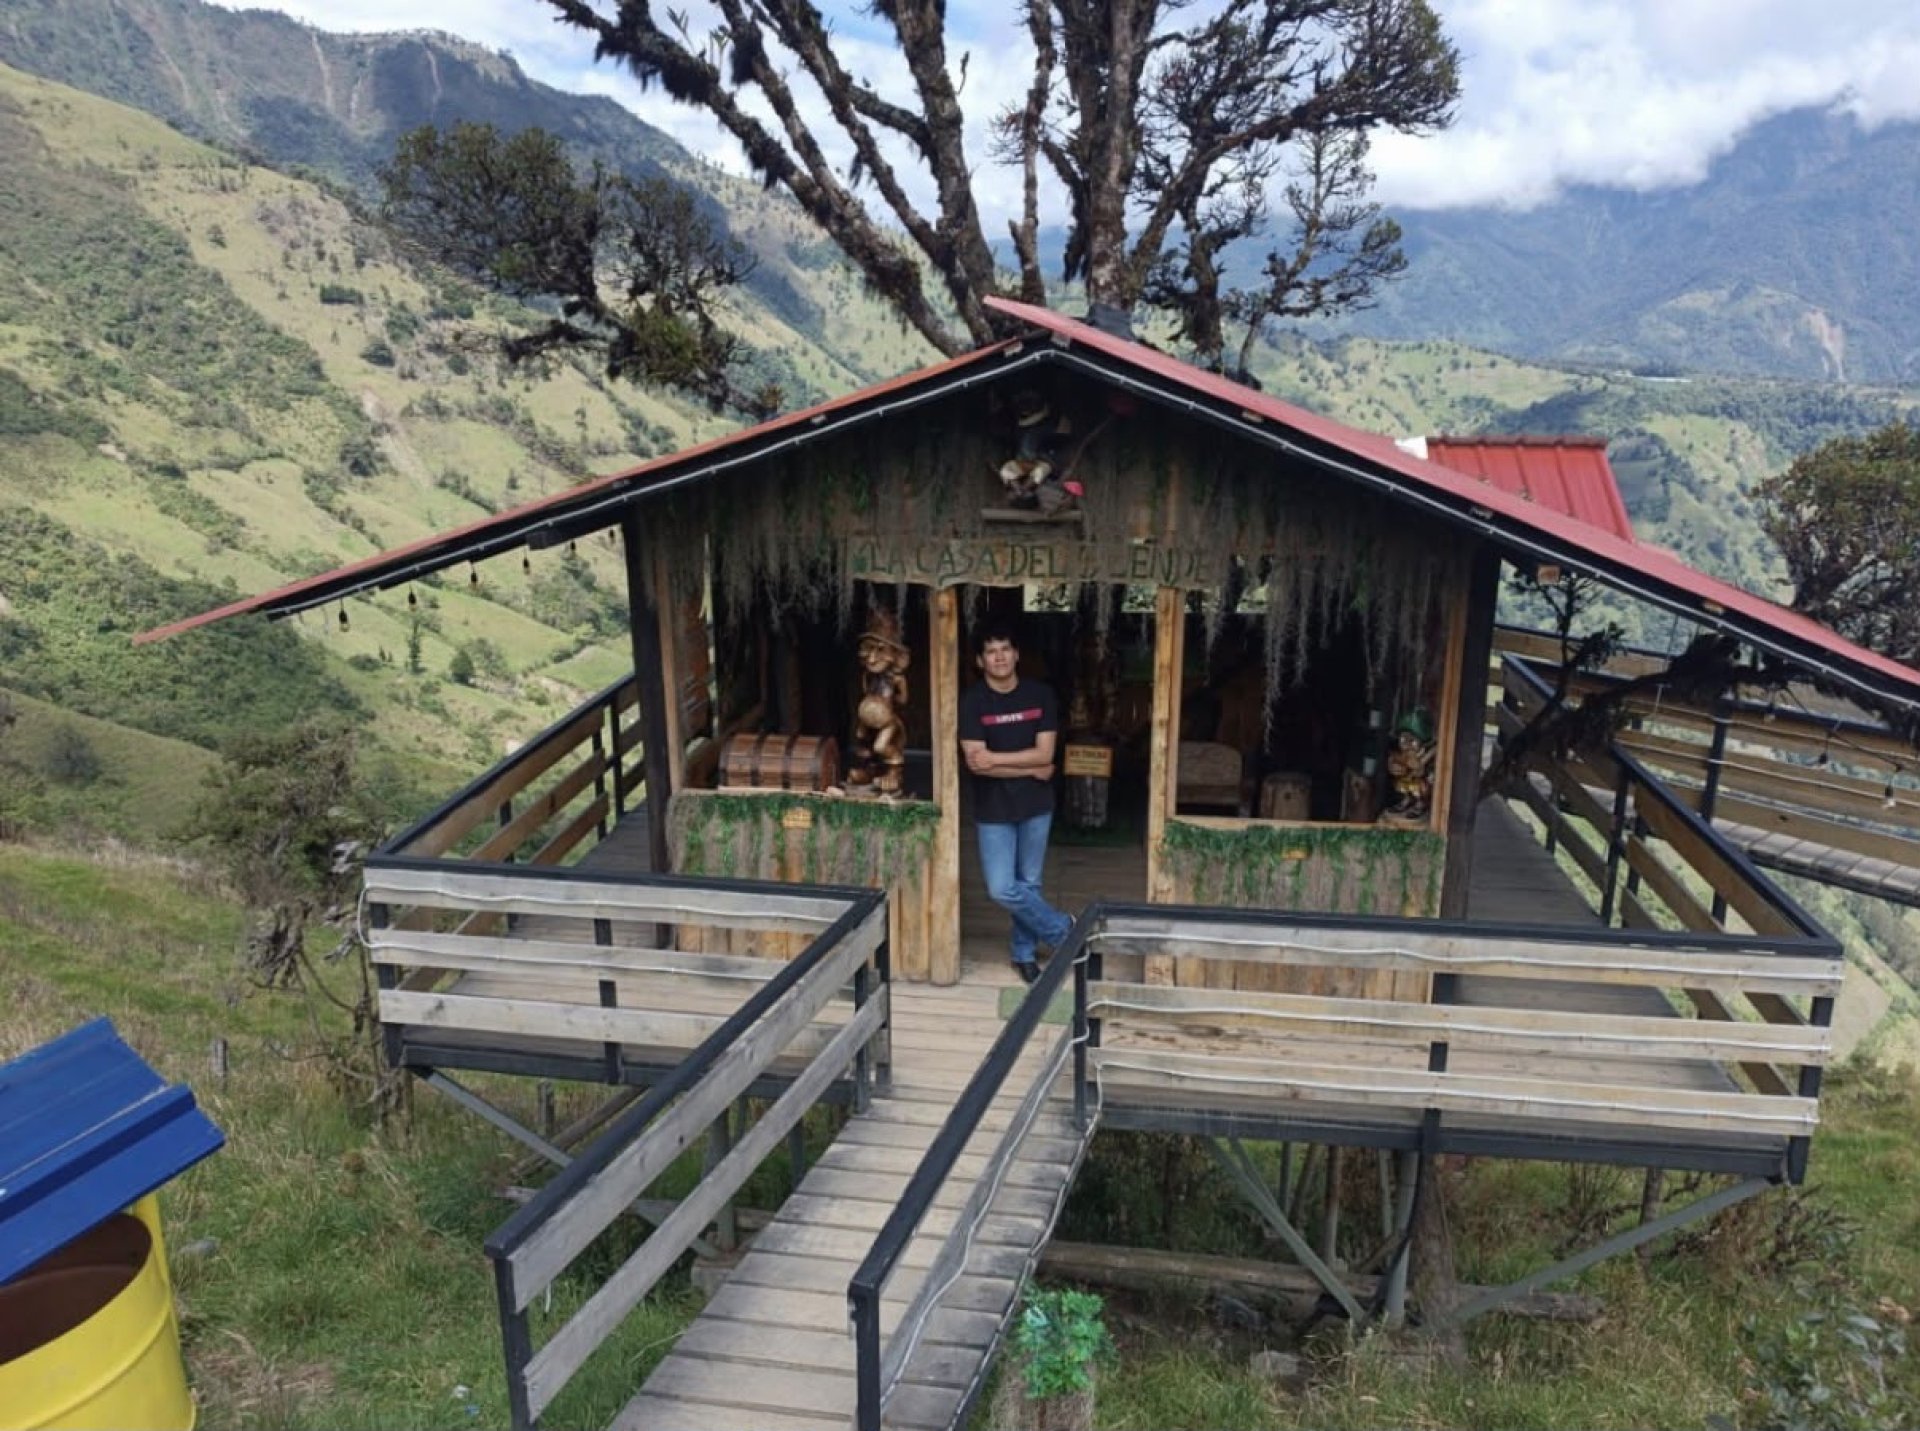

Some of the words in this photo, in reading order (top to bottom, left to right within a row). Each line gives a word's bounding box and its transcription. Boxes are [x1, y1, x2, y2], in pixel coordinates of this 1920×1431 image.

[868, 543, 906, 575] LA
[915, 544, 999, 586] CASA
[1004, 544, 1067, 581] DEL
